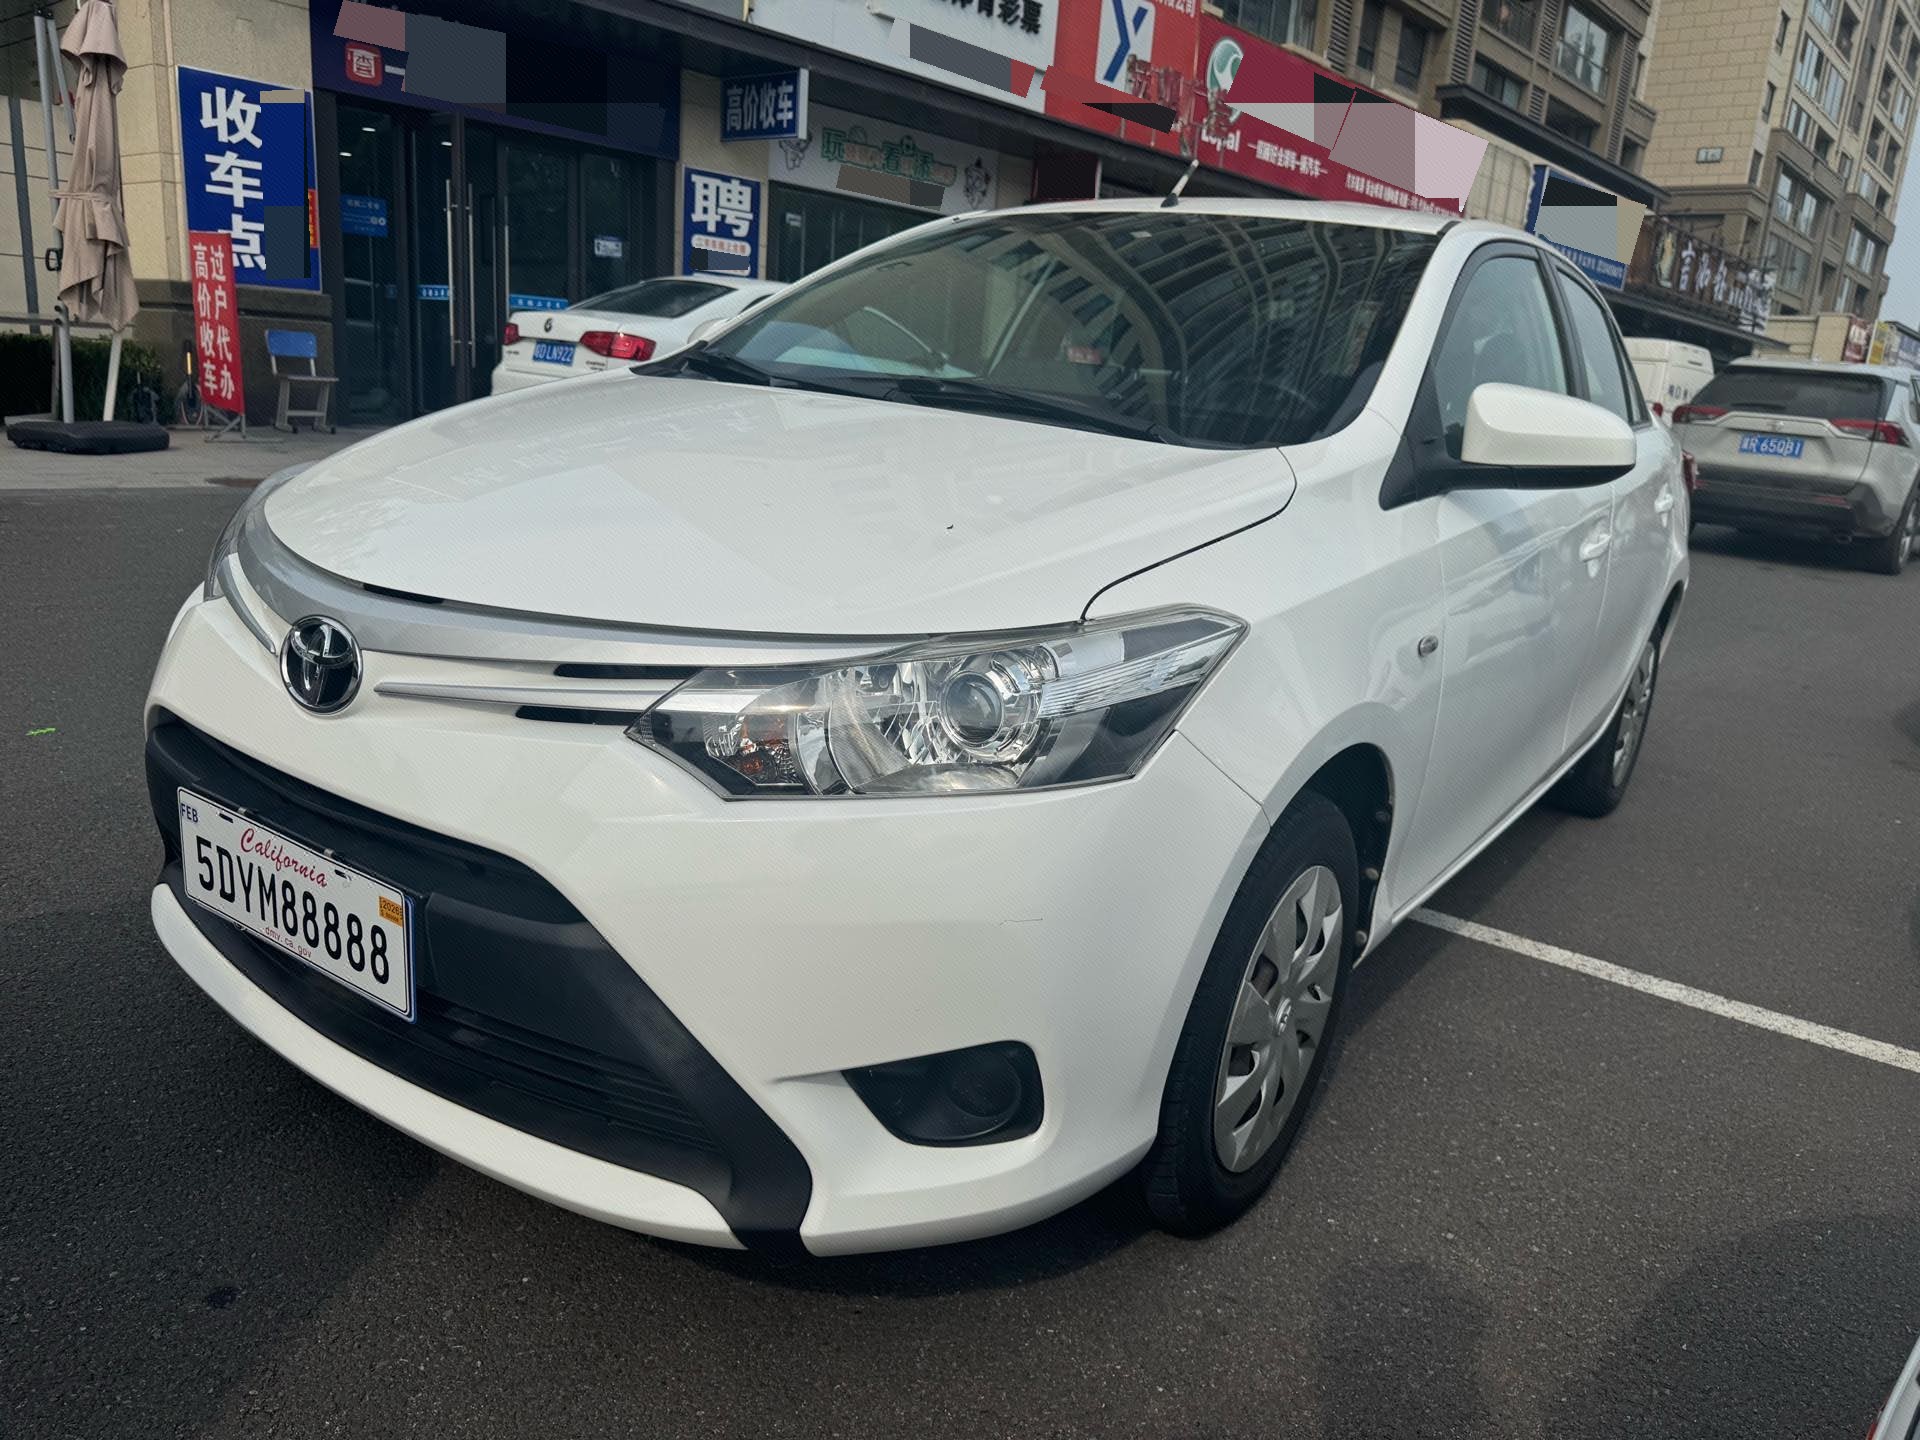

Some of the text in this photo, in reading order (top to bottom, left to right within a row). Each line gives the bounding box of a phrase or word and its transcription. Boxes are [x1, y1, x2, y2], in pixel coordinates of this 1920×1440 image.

[726, 79, 795, 133] 高价收车
[200, 86, 267, 271] 收车点
[690, 173, 754, 238] 聘
[192, 243, 219, 396] 高价收车
[210, 244, 236, 400] 过户代办
[180, 802, 199, 823] FEB
[240, 827, 328, 888] California
[195, 834, 391, 985] 5DYM88888
[382, 899, 400, 915] 2026
[264, 926, 313, 958] dmv.ca.gov
